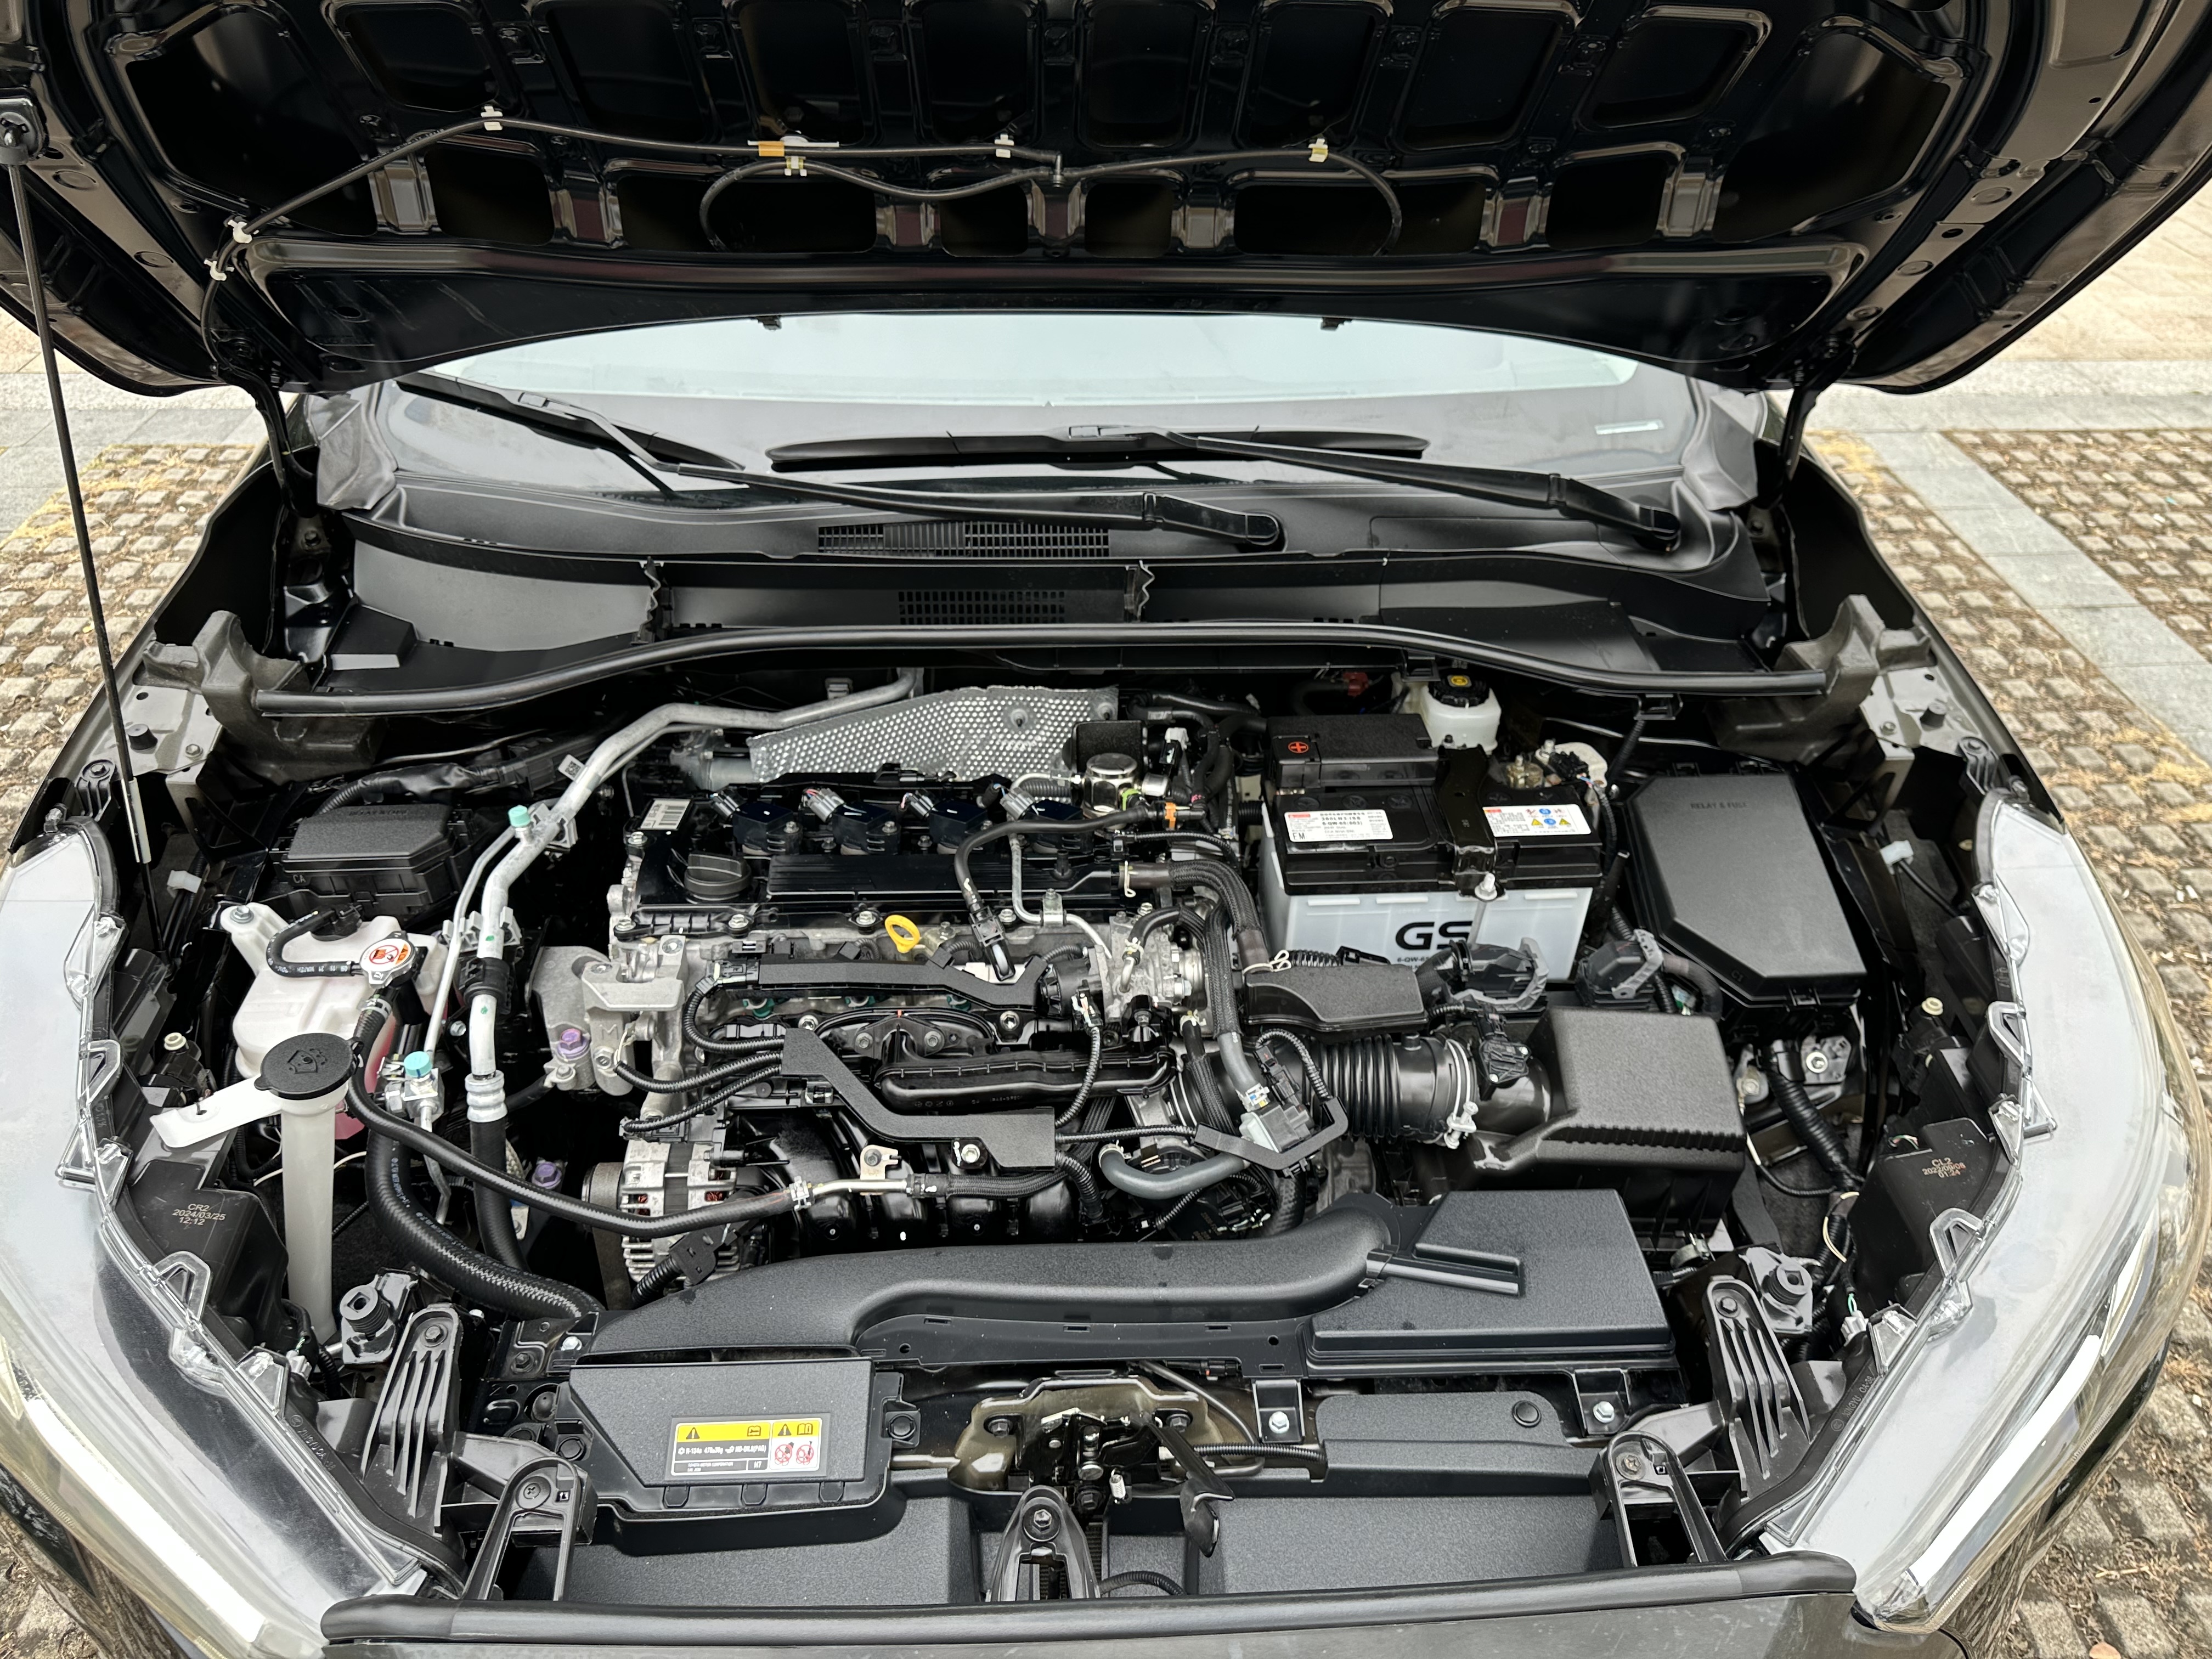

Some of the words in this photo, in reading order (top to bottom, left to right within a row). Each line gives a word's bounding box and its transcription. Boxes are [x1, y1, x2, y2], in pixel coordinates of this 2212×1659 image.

[1395, 921, 1474, 950] GS
[1931, 1157, 1953, 1167] CL2
[188, 1203, 210, 1212] CR2
[171, 1209, 227, 1221] 2024/03/25
[179, 1216, 206, 1226] 12:12
[1842, 1395, 1861, 1418] XINGYU
